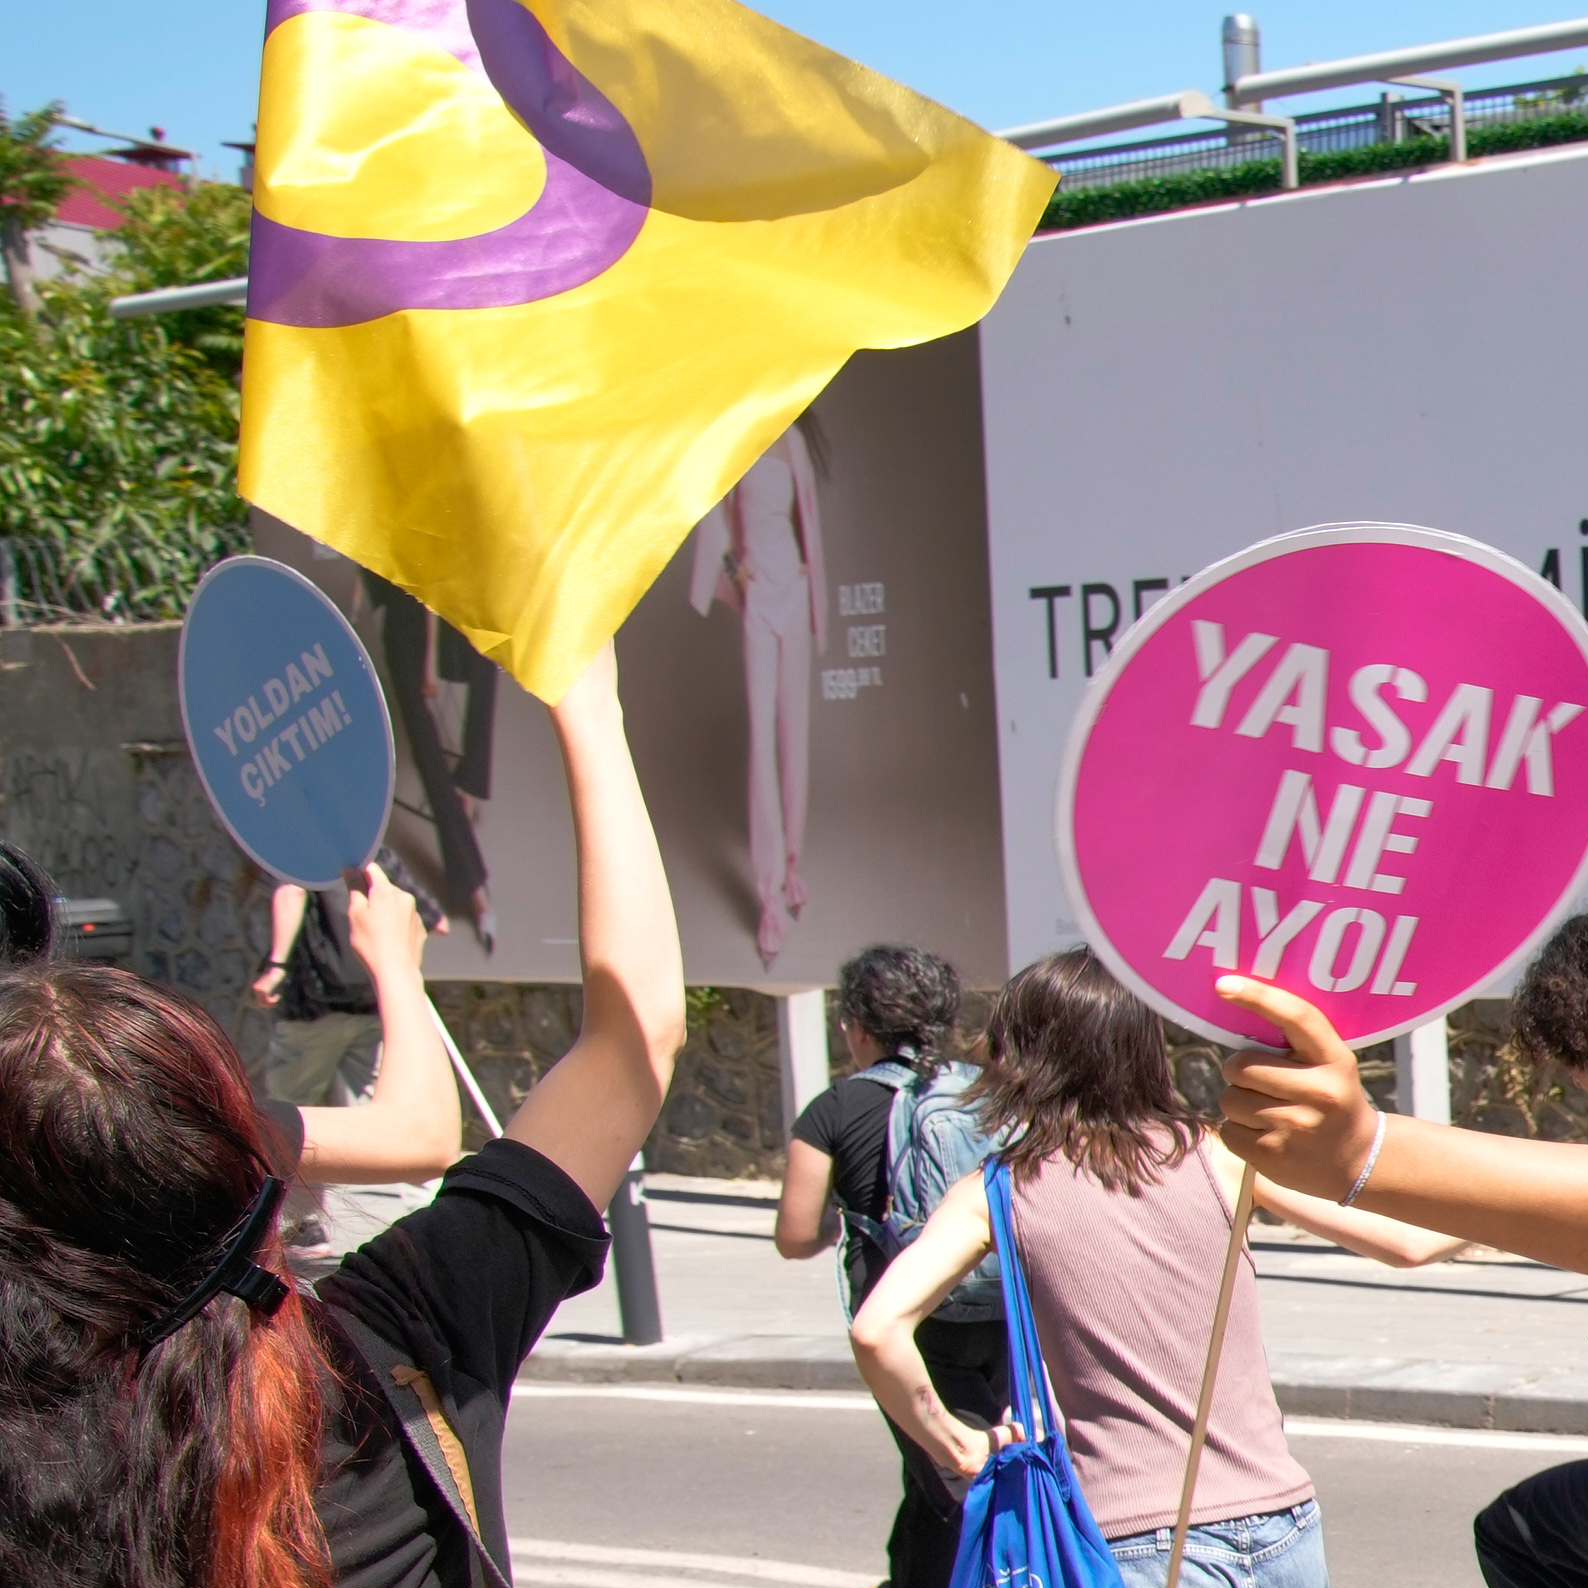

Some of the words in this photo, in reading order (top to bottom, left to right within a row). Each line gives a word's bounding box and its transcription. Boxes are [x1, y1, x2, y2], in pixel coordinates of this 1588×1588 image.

[213, 642, 334, 757] YOLDAN
[240, 689, 353, 807] ÇIKTIM!
[1190, 618, 1587, 798] YASAK
[1253, 769, 1434, 895] NE
[1162, 877, 1421, 998] AYOL
